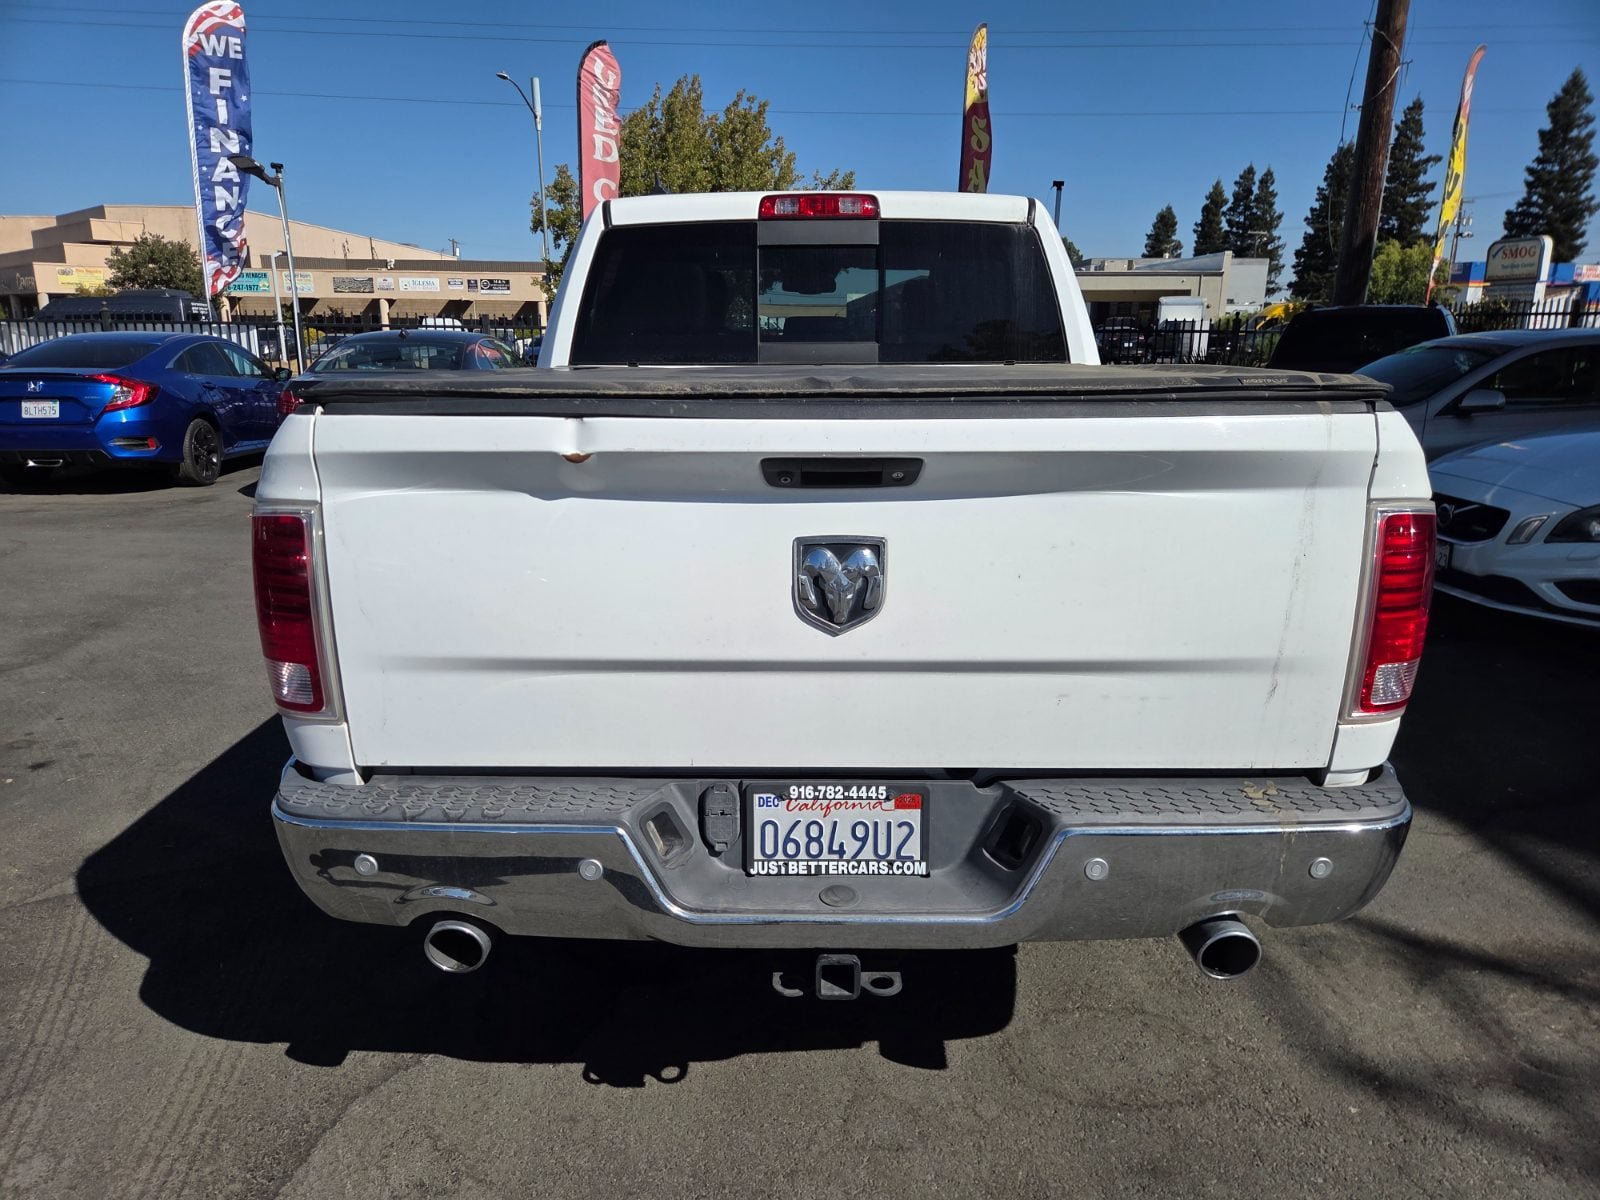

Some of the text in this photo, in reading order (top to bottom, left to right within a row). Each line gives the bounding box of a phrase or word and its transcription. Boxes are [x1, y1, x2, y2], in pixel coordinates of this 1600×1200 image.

[199, 33, 243, 60] WE
[592, 56, 619, 163] USED
[209, 66, 240, 266] FINANCE
[1501, 245, 1537, 260] SMOG
[24, 406, 57, 416] 8LTH575
[789, 785, 887, 799] 916-782-4445
[758, 796, 779, 808] DEC
[785, 799, 896, 818] California
[760, 819, 915, 860] 06849U2
[750, 861, 927, 875] JUSTBETTERCARS.COM
